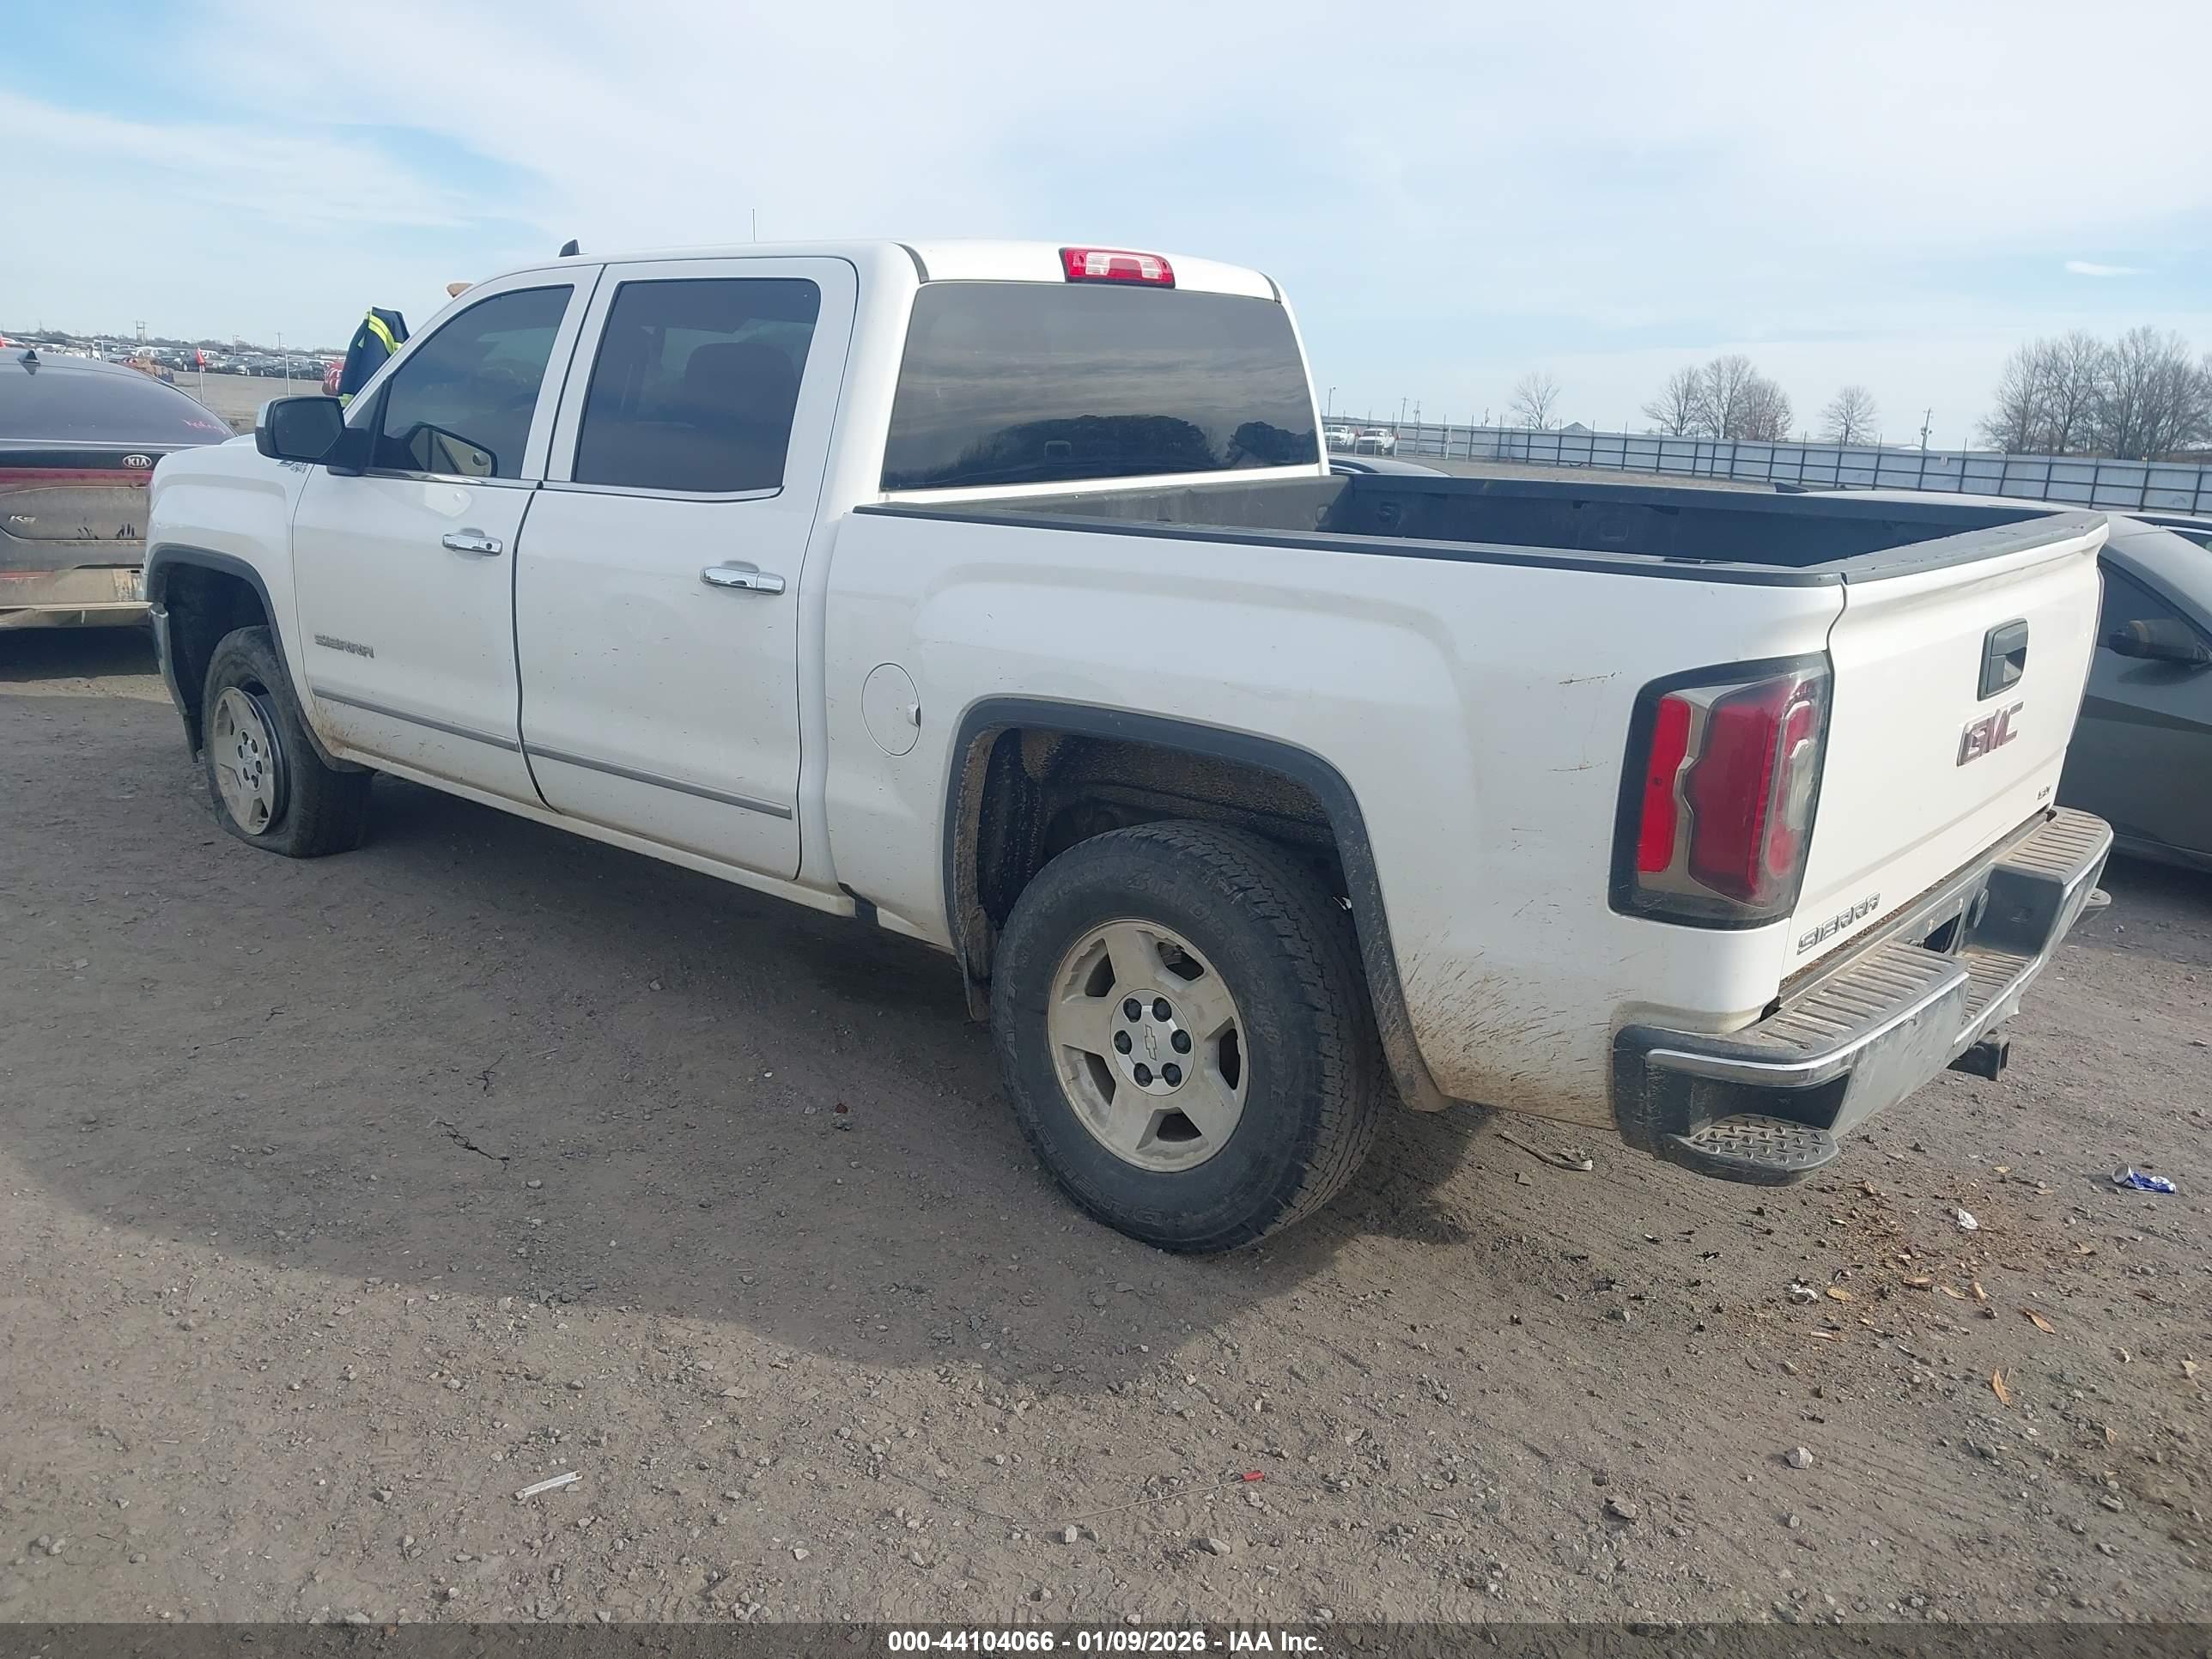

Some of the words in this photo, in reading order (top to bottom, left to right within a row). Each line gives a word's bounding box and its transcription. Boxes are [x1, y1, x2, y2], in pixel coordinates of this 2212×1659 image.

[126, 457, 149, 467] KIA
[313, 634, 374, 659] SIERRA
[1956, 700, 2025, 767] GMC
[1796, 891, 1881, 956] SIERRA
